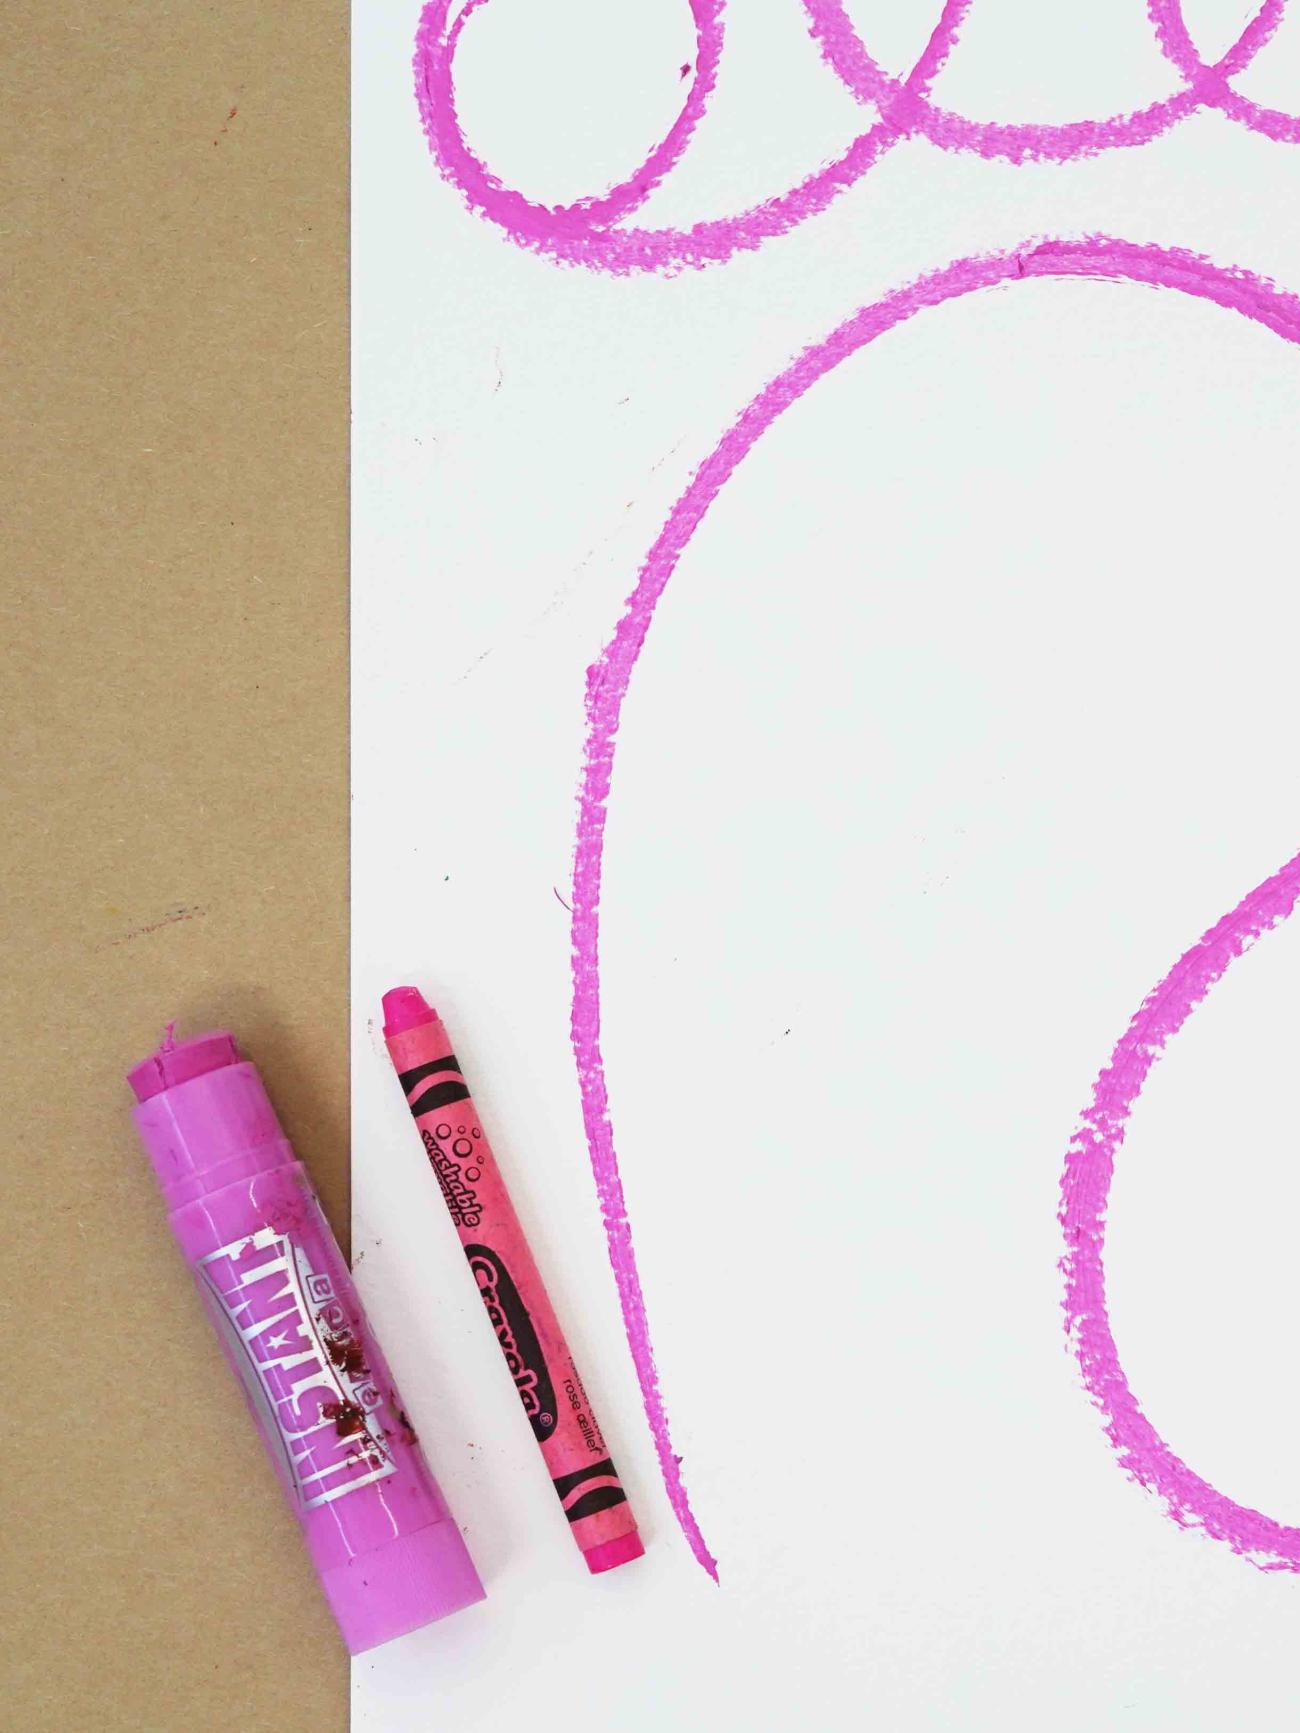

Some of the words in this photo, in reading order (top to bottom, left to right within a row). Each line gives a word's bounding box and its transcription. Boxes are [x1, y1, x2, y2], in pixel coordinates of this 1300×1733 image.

[422, 1129, 482, 1227] washable
[201, 1236, 387, 1502] INSTANT
[563, 1378, 582, 1411] rose
